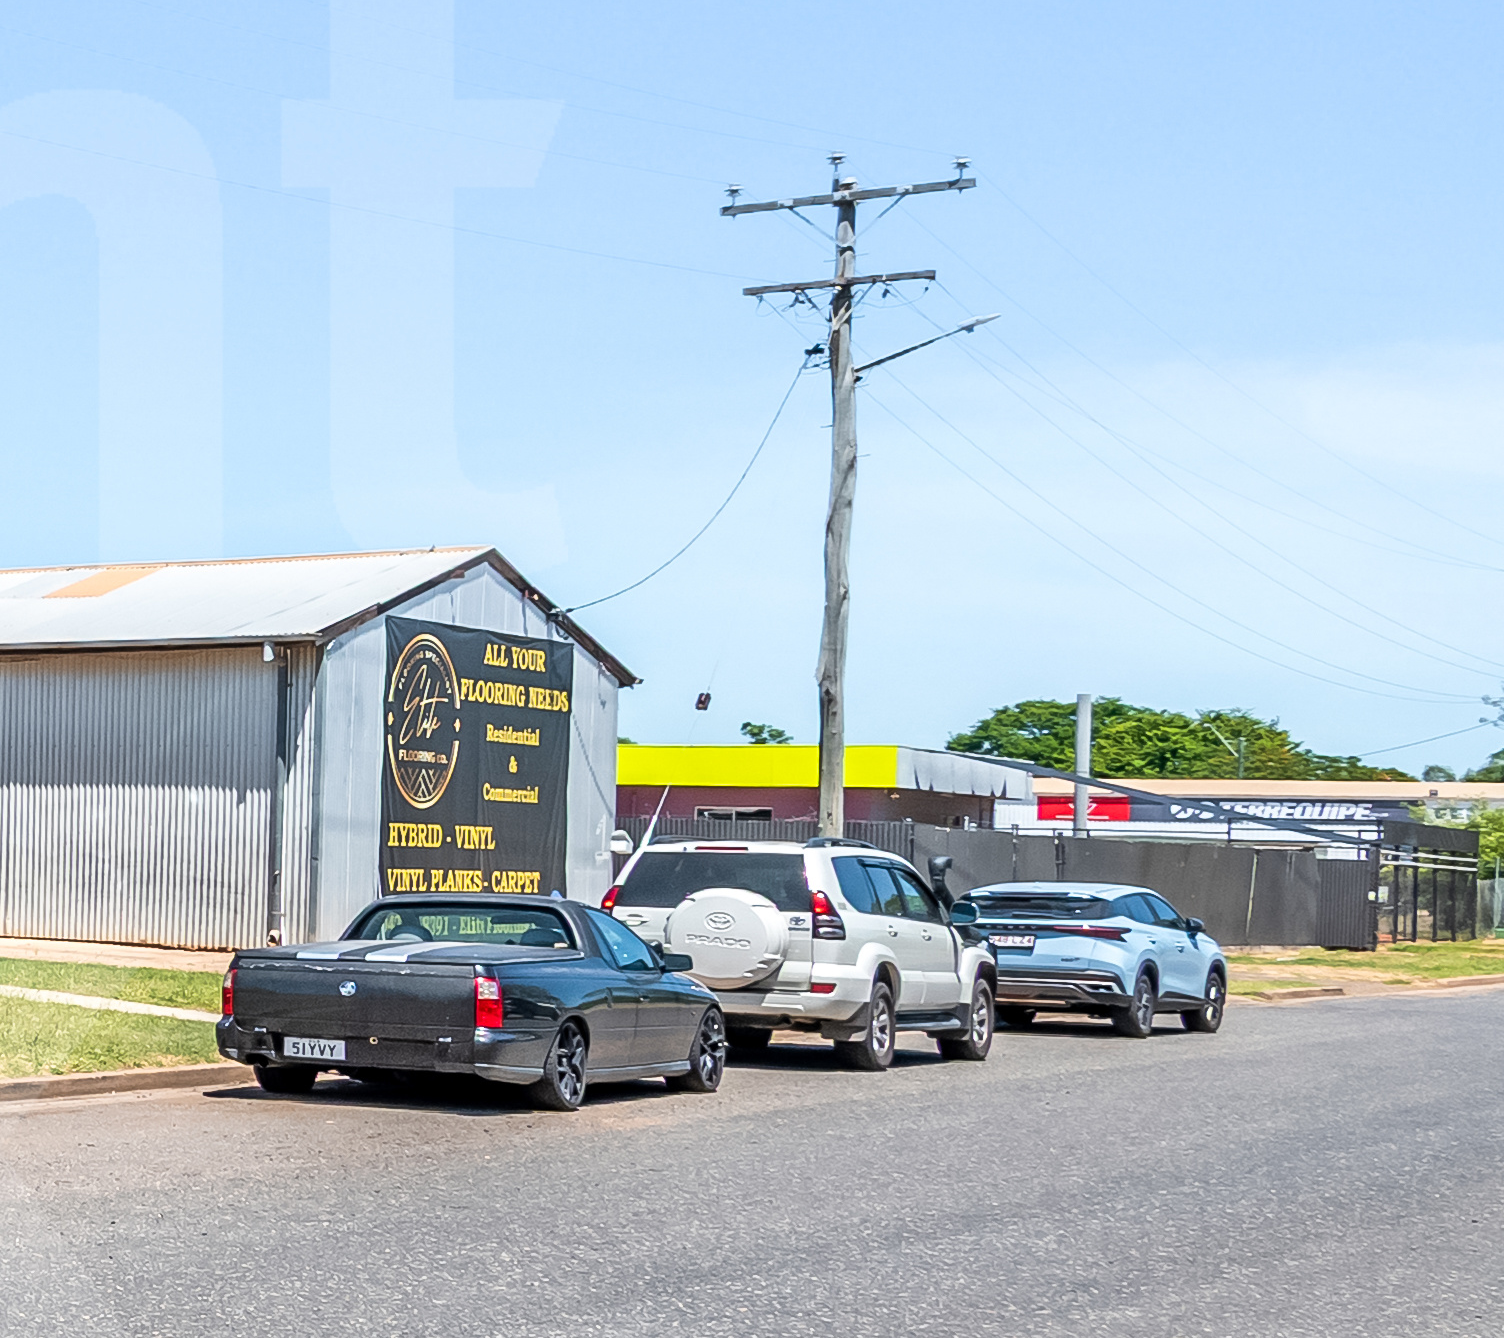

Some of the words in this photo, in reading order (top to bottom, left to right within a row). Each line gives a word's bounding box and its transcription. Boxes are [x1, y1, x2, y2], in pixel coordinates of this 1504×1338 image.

[484, 643, 508, 667] ALL
[511, 646, 546, 673] YOUR
[460, 678, 526, 708] FLOORING
[528, 687, 569, 712] NEEDS
[486, 724, 540, 746] Residential
[508, 755, 518, 774] &
[483, 782, 539, 804] Commercial
[387, 822, 443, 848] HYBRID
[454, 825, 496, 850] VINYL
[387, 868, 428, 892] VINYL
[491, 871, 541, 894] CARPET
[685, 934, 751, 950] PRADO
